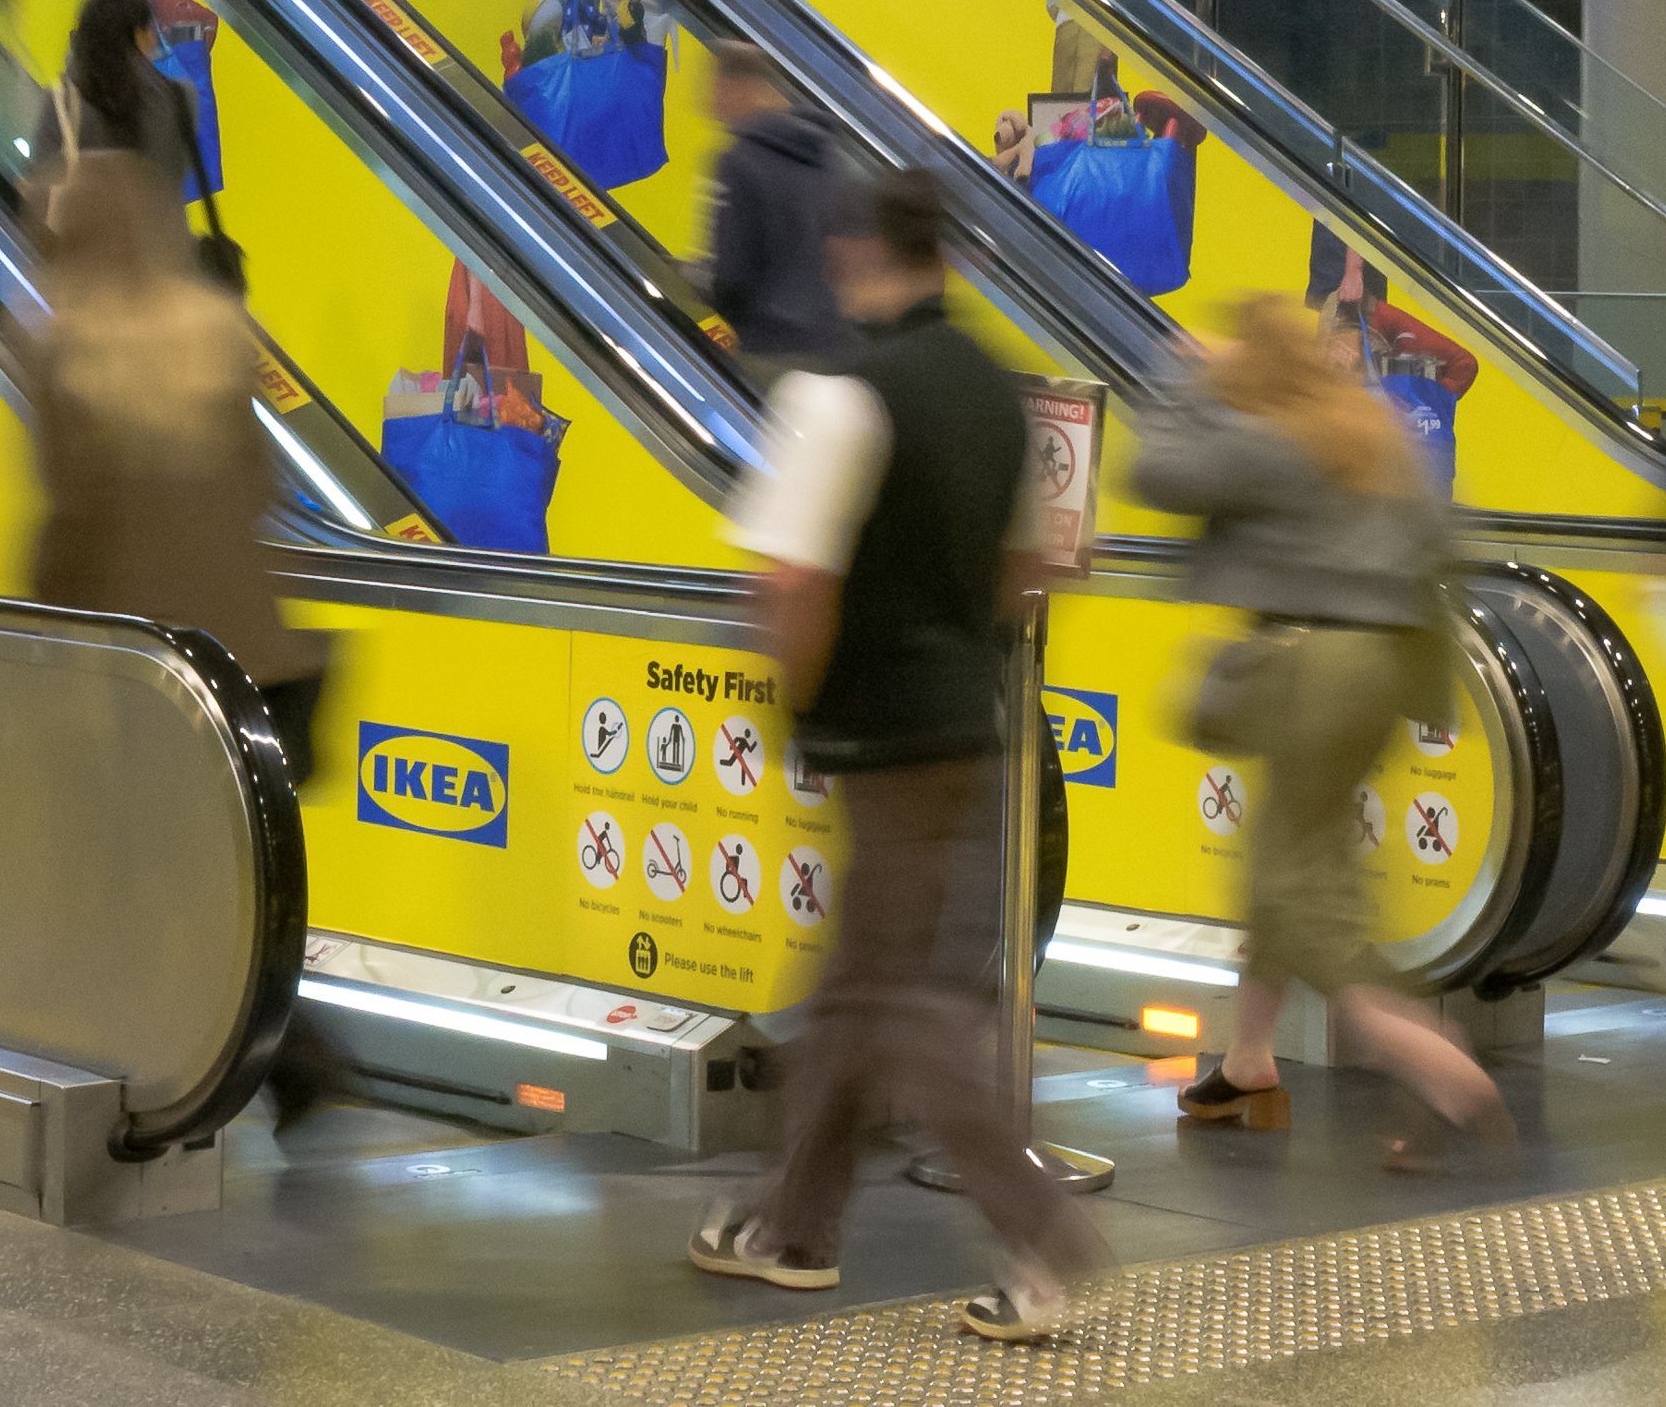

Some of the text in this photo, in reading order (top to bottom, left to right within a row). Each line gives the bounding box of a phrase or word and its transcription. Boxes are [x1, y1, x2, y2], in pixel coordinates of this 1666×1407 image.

[398, 25, 439, 58] LEFT
[527, 150, 606, 221] KEEP LEFT
[646, 660, 776, 705] Safety First
[1410, 766, 1422, 777] No
[374, 754, 495, 813] IKEA
[573, 782, 591, 794] Hold
[642, 793, 698, 814] Hold your child
[716, 806, 759, 825] No running
[785, 816, 797, 828] No
[1200, 844, 1212, 856] No
[1412, 874, 1450, 889] No prams
[579, 897, 621, 916] No bicycles
[639, 909, 683, 927] No scooters
[704, 922, 763, 943] No wheelchairs
[786, 938, 797, 950] No
[665, 952, 755, 984] Please use the lift
